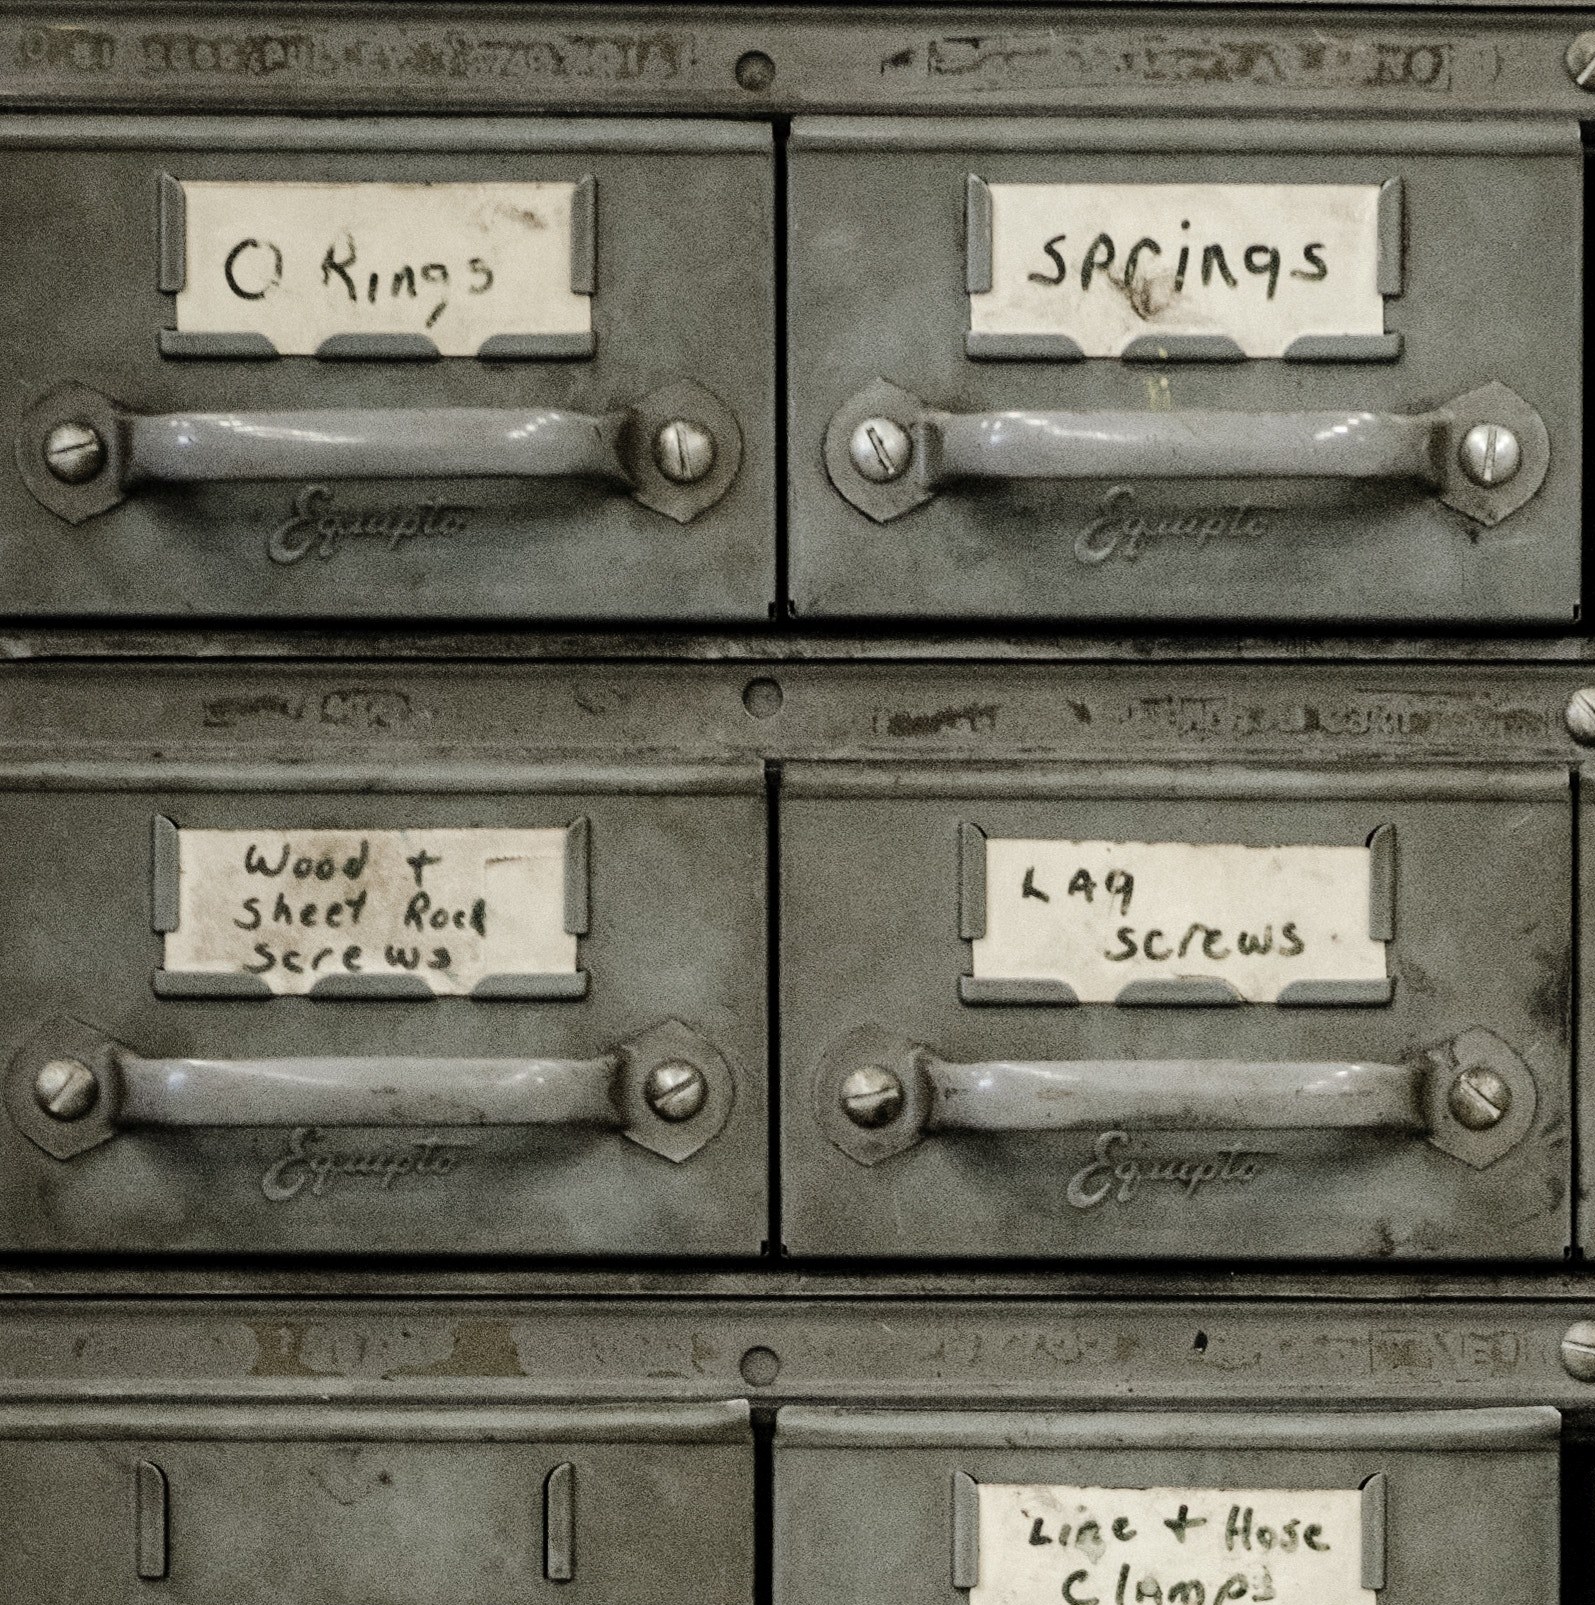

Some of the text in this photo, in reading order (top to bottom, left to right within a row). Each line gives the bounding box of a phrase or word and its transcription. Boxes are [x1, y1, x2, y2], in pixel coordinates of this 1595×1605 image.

[224, 231, 495, 327] O Rings
[245, 841, 370, 883] Wood
[1224, 1505, 1332, 1553] Hose
